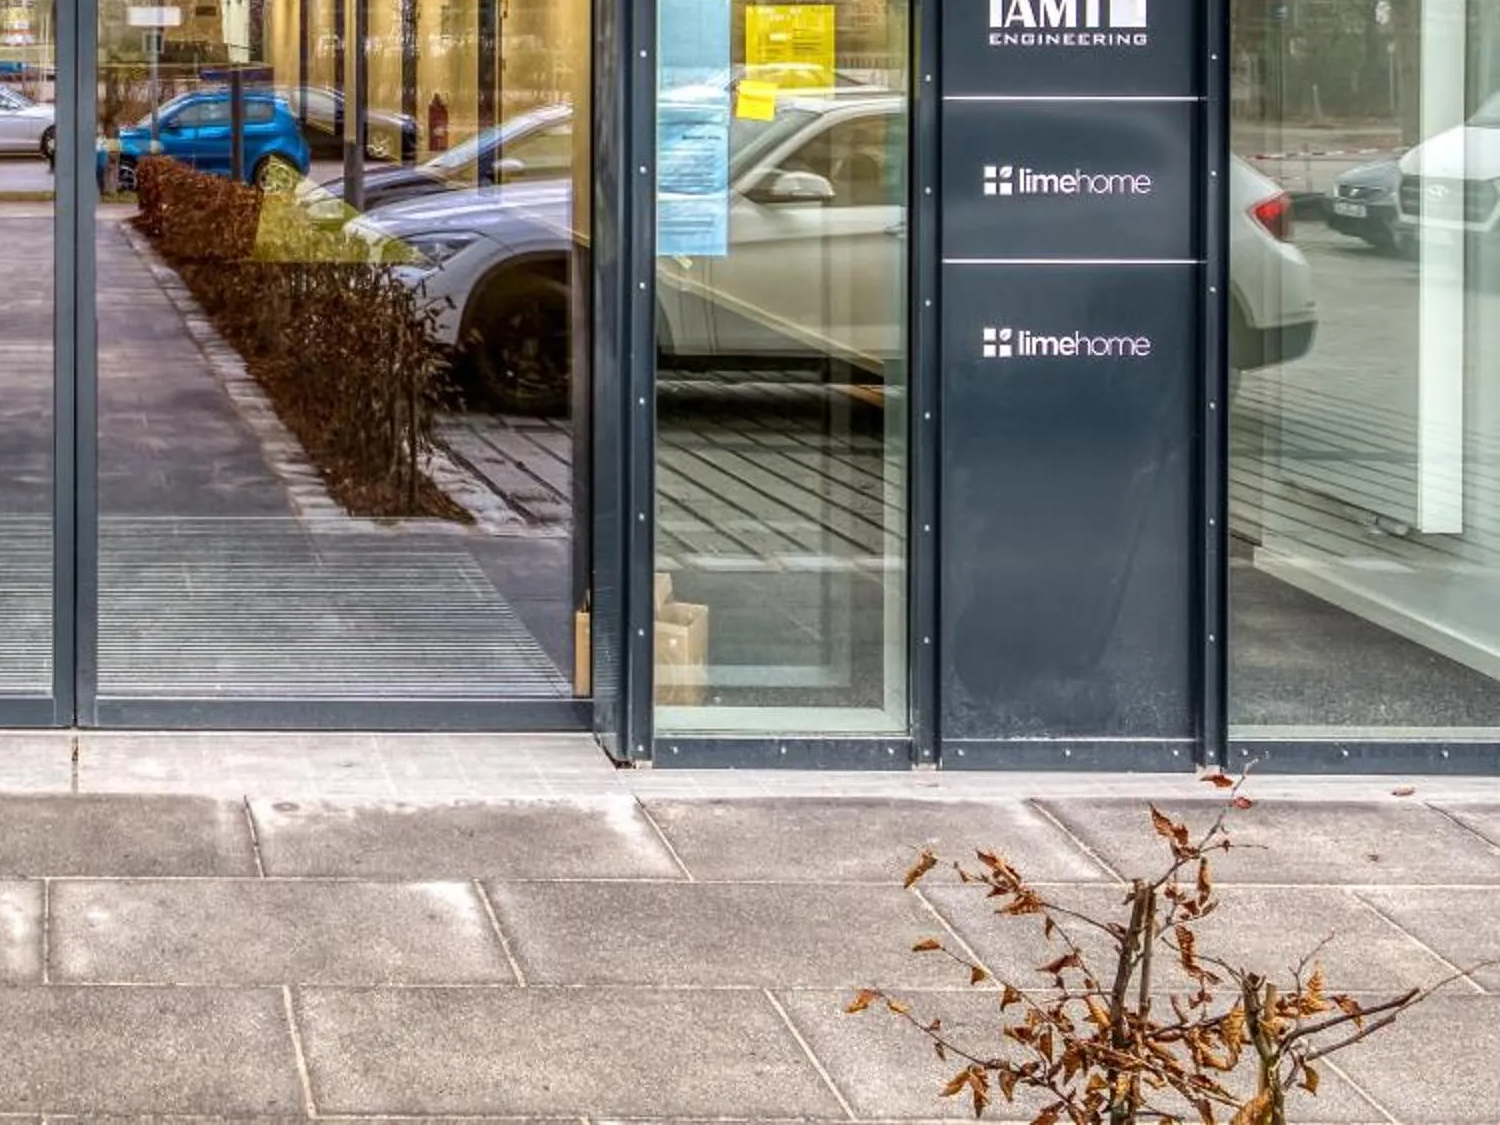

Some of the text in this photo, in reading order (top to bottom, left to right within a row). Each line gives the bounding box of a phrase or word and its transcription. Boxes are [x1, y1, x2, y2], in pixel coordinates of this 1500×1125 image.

[988, 33, 1148, 45] ENGINEERING
[1018, 167, 1152, 194] limehome
[1017, 330, 1151, 356] limehome
